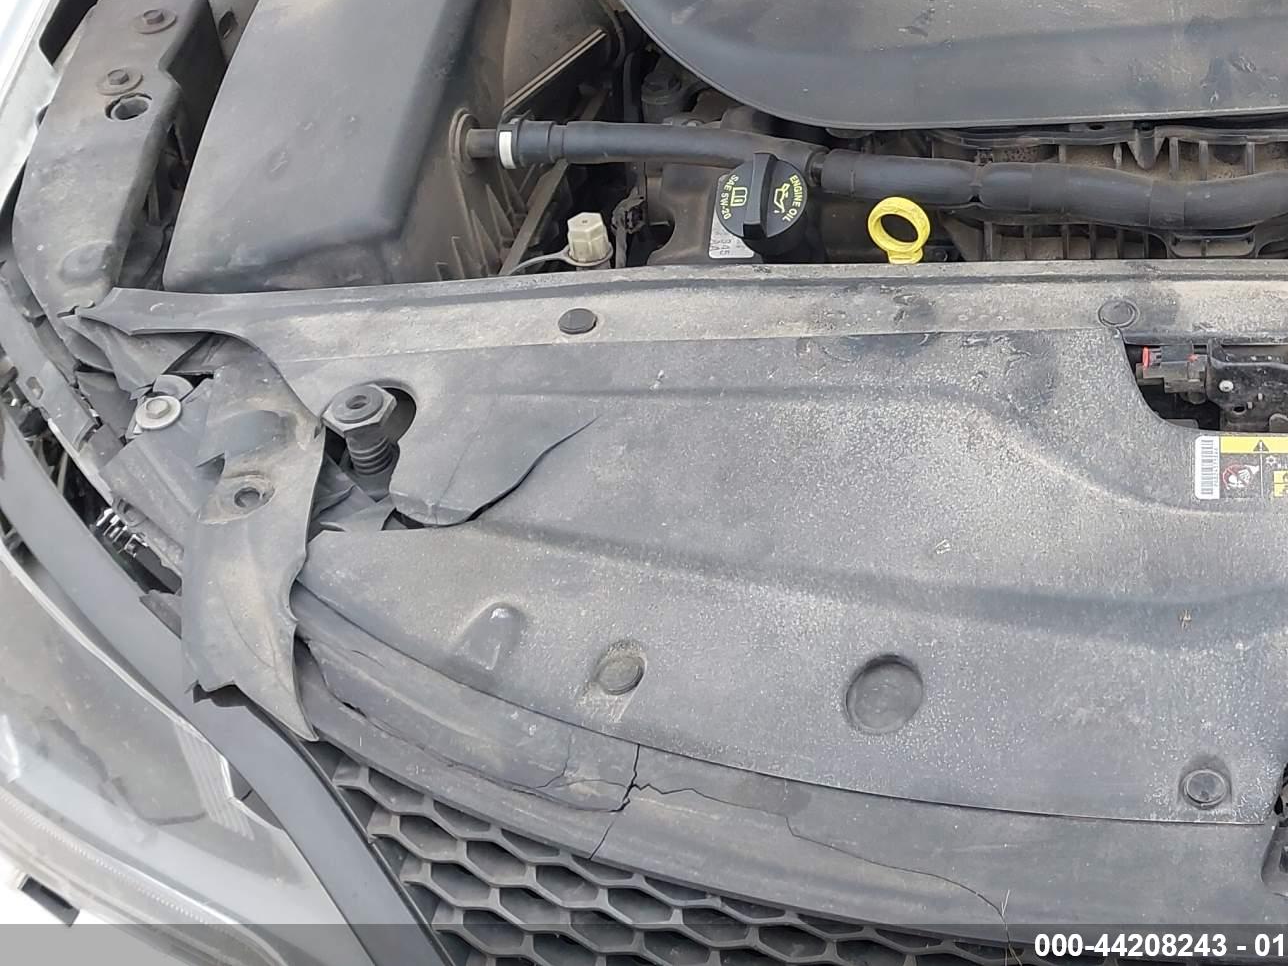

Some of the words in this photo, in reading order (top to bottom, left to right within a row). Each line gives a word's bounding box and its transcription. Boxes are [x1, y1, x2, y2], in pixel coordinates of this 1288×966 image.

[724, 175, 739, 191] SAE
[789, 174, 803, 207] ENGINE
[720, 192, 732, 220] 5W-20
[782, 208, 798, 222] OIL
